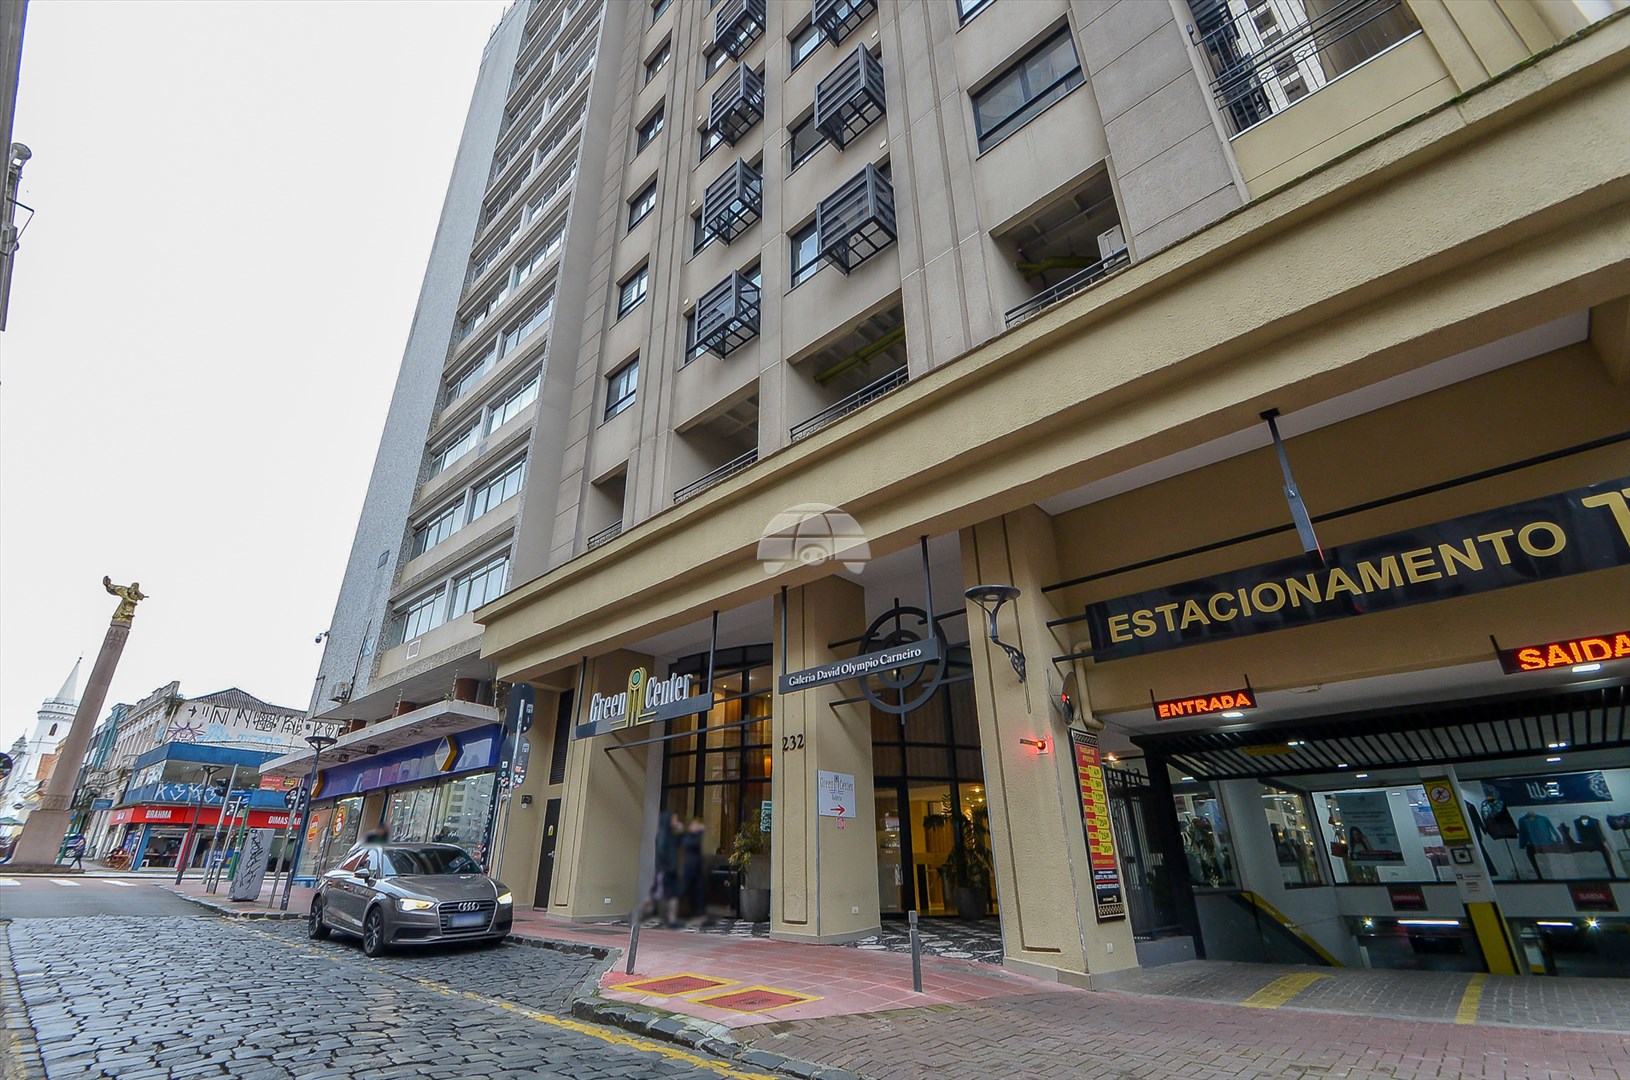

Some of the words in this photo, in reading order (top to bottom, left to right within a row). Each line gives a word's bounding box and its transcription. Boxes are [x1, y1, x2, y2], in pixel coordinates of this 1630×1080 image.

[1108, 521, 1567, 643] ESTACIONAMENTO
[788, 672, 816, 686] Galeria
[816, 667, 840, 681] David
[841, 659, 879, 676] Olympio
[880, 648, 922, 665] Carneiro
[589, 691, 628, 722] Green
[645, 672, 693, 709] Center
[1158, 693, 1251, 717] ENTRADA
[782, 734, 804, 751] 232
[145, 810, 172, 819] BRAHMA
[268, 815, 289, 825] DIMAS
